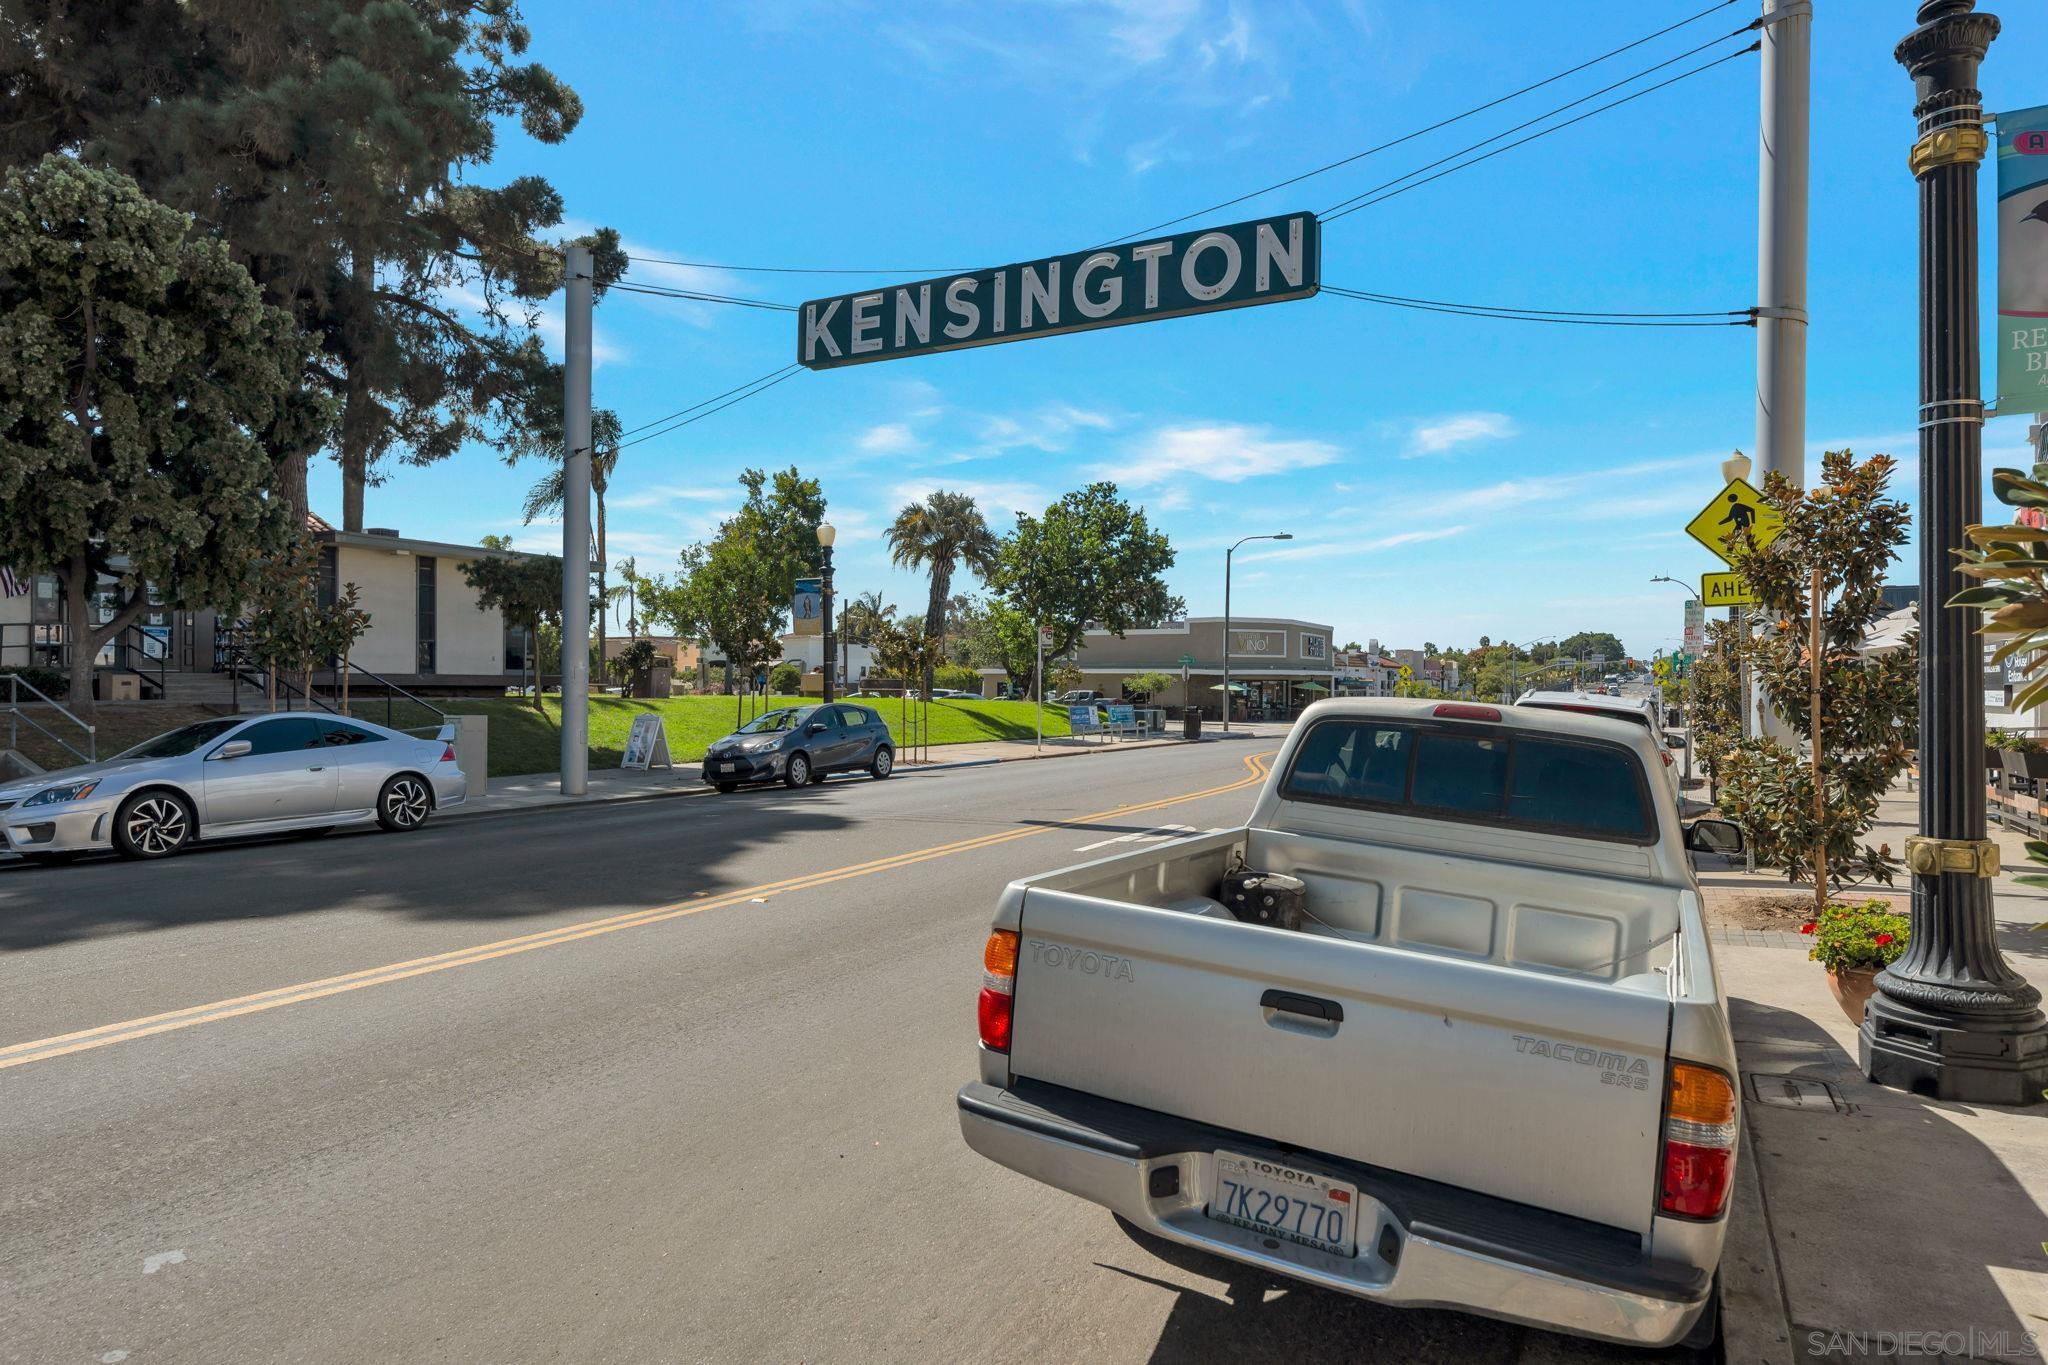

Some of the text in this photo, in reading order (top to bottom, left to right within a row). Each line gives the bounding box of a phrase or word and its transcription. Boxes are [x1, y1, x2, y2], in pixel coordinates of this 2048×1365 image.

[805, 217, 1303, 361] KENSINGTON
[1711, 581, 1755, 598] AHE
[1030, 940, 1134, 983] TOYOTA
[1512, 1035, 1650, 1077] TACOMA
[1252, 1161, 1316, 1186] TOYOTA
[1223, 1180, 1343, 1244] 7K29770
[1233, 1217, 1327, 1252] KEARNY MESA
